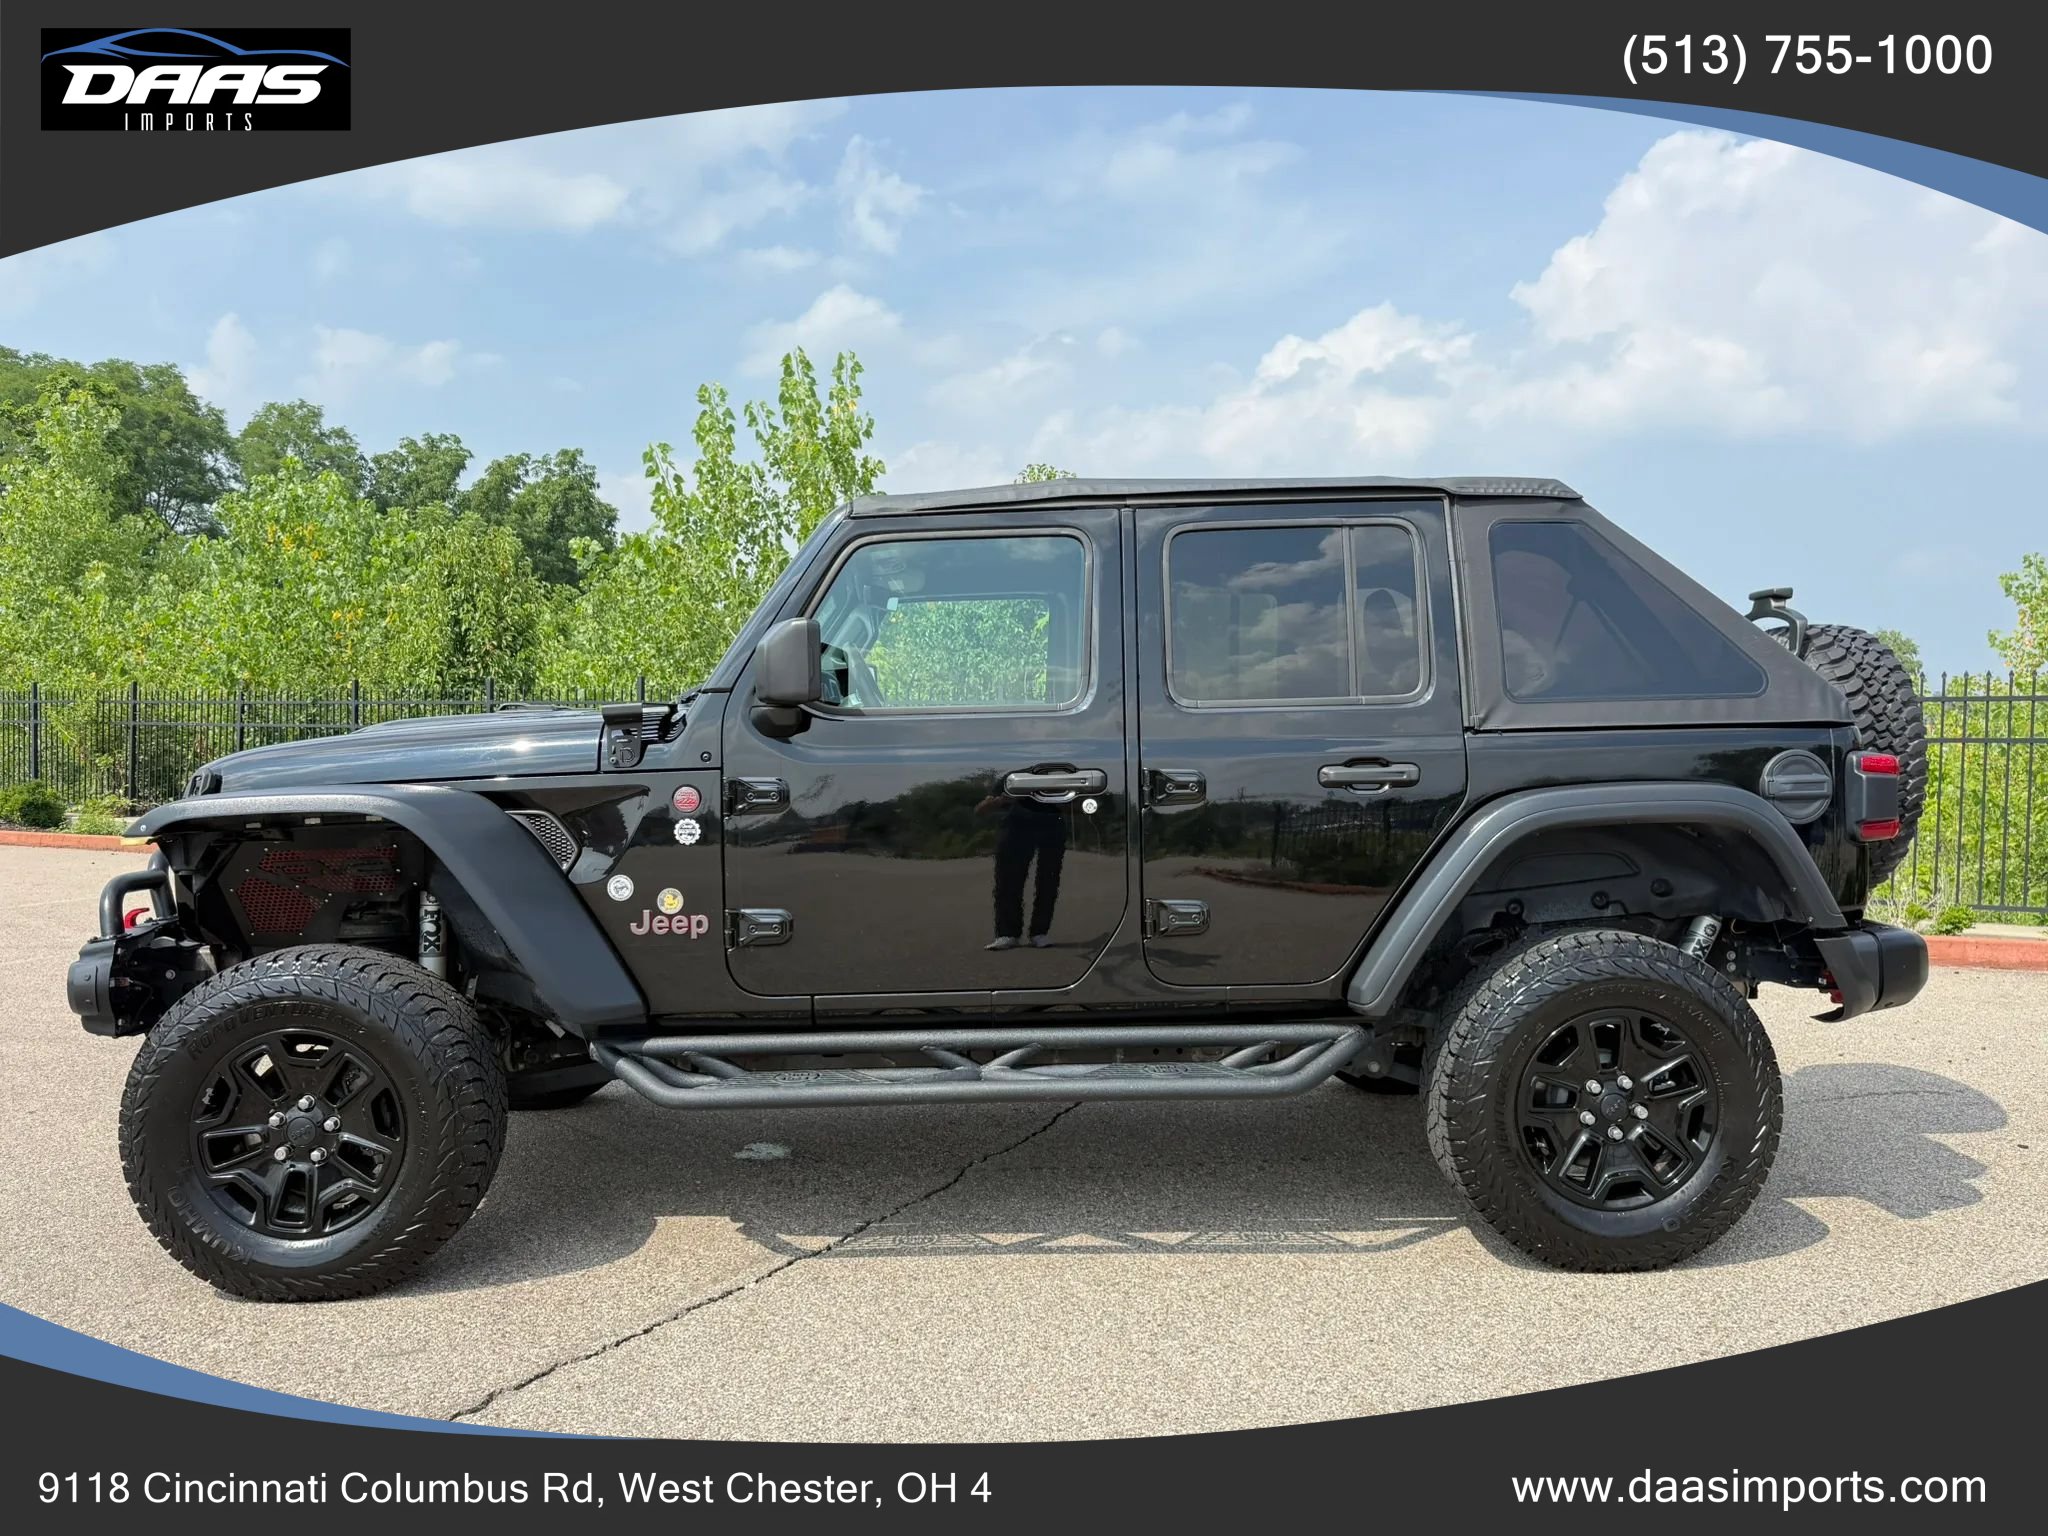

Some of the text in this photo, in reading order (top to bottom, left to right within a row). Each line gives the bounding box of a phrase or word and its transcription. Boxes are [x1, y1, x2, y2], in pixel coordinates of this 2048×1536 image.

[421, 908, 442, 953] FOX
[630, 909, 709, 940] Jeep
[236, 1000, 335, 1026] VENTURE
[167, 1185, 257, 1266] KUMHO
